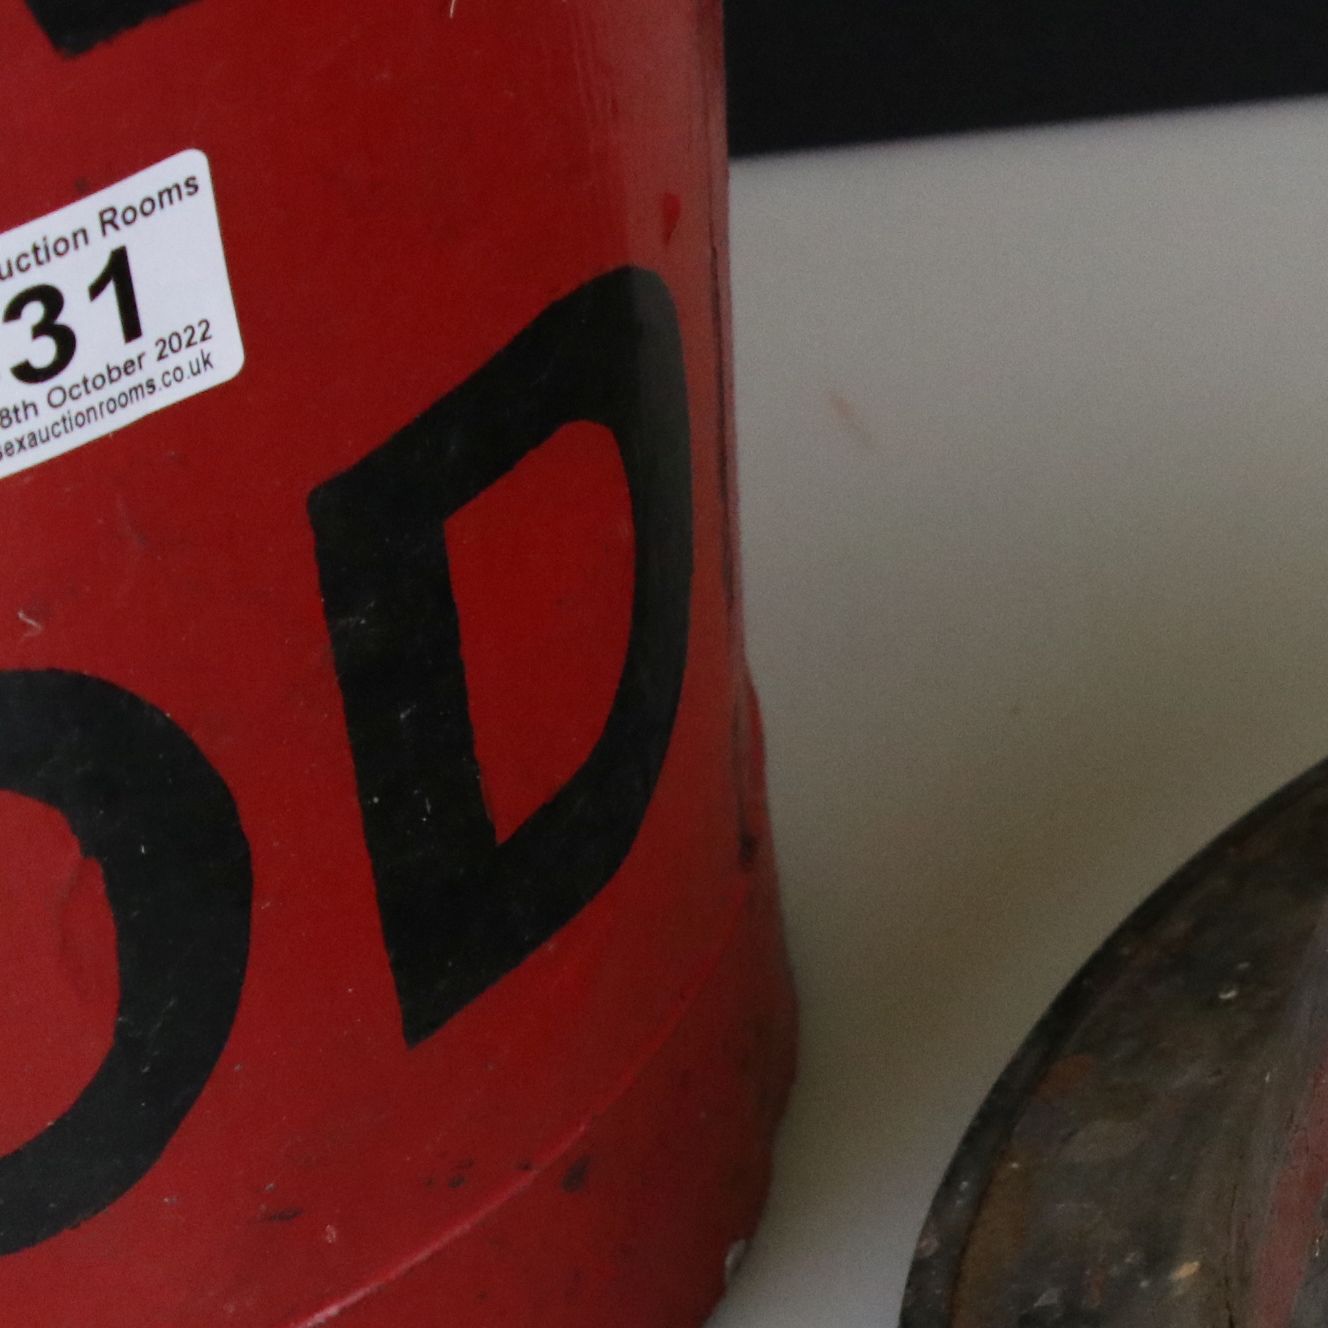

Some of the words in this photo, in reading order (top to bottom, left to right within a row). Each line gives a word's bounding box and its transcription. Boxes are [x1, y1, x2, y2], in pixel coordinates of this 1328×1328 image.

[98, 174, 199, 238] Rooms
[2, 244, 143, 384] 31
[47, 352, 147, 409] October
[155, 319, 213, 361] 2022
[0, 350, 214, 461] exauctionrooms.co.uk
